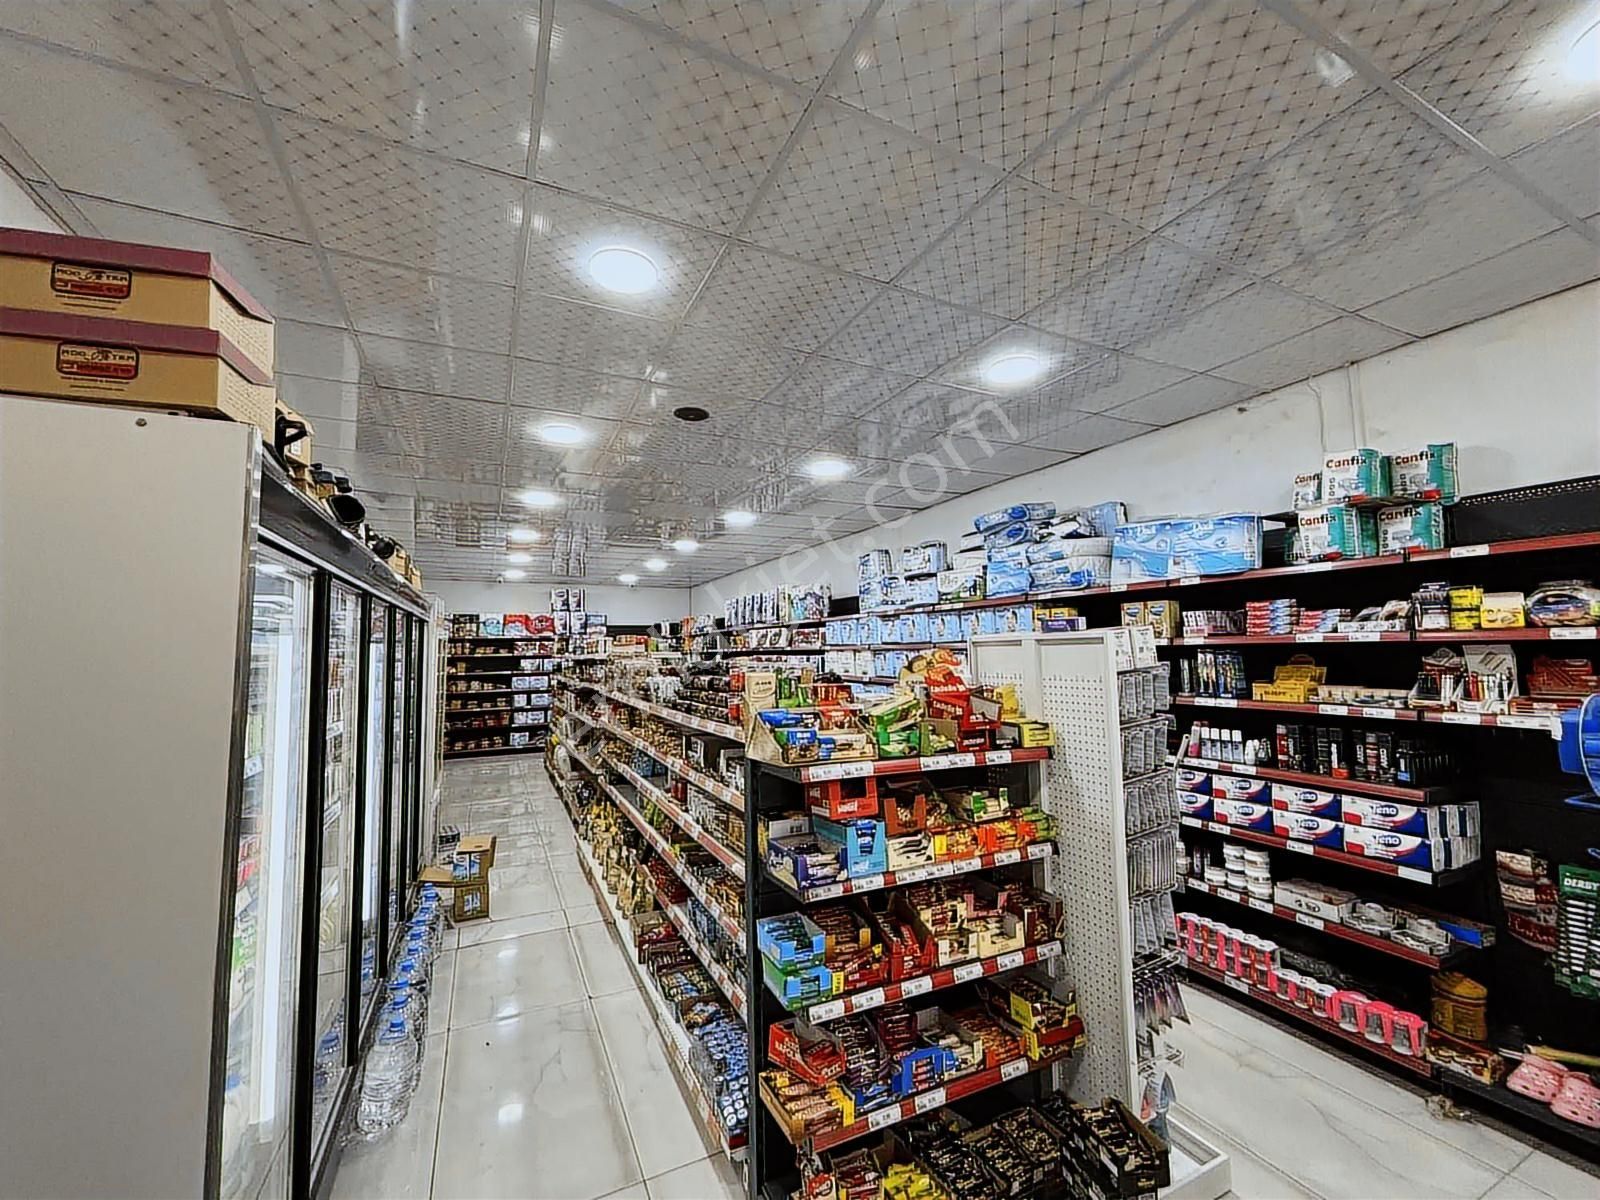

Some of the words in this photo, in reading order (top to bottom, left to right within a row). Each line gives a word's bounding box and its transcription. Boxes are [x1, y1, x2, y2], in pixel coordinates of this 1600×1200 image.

[1326, 455, 1367, 469] Canfix
[1395, 450, 1435, 467] Canfix
[1300, 513, 1337, 527] Canfix
[1379, 506, 1422, 523] Canfix
